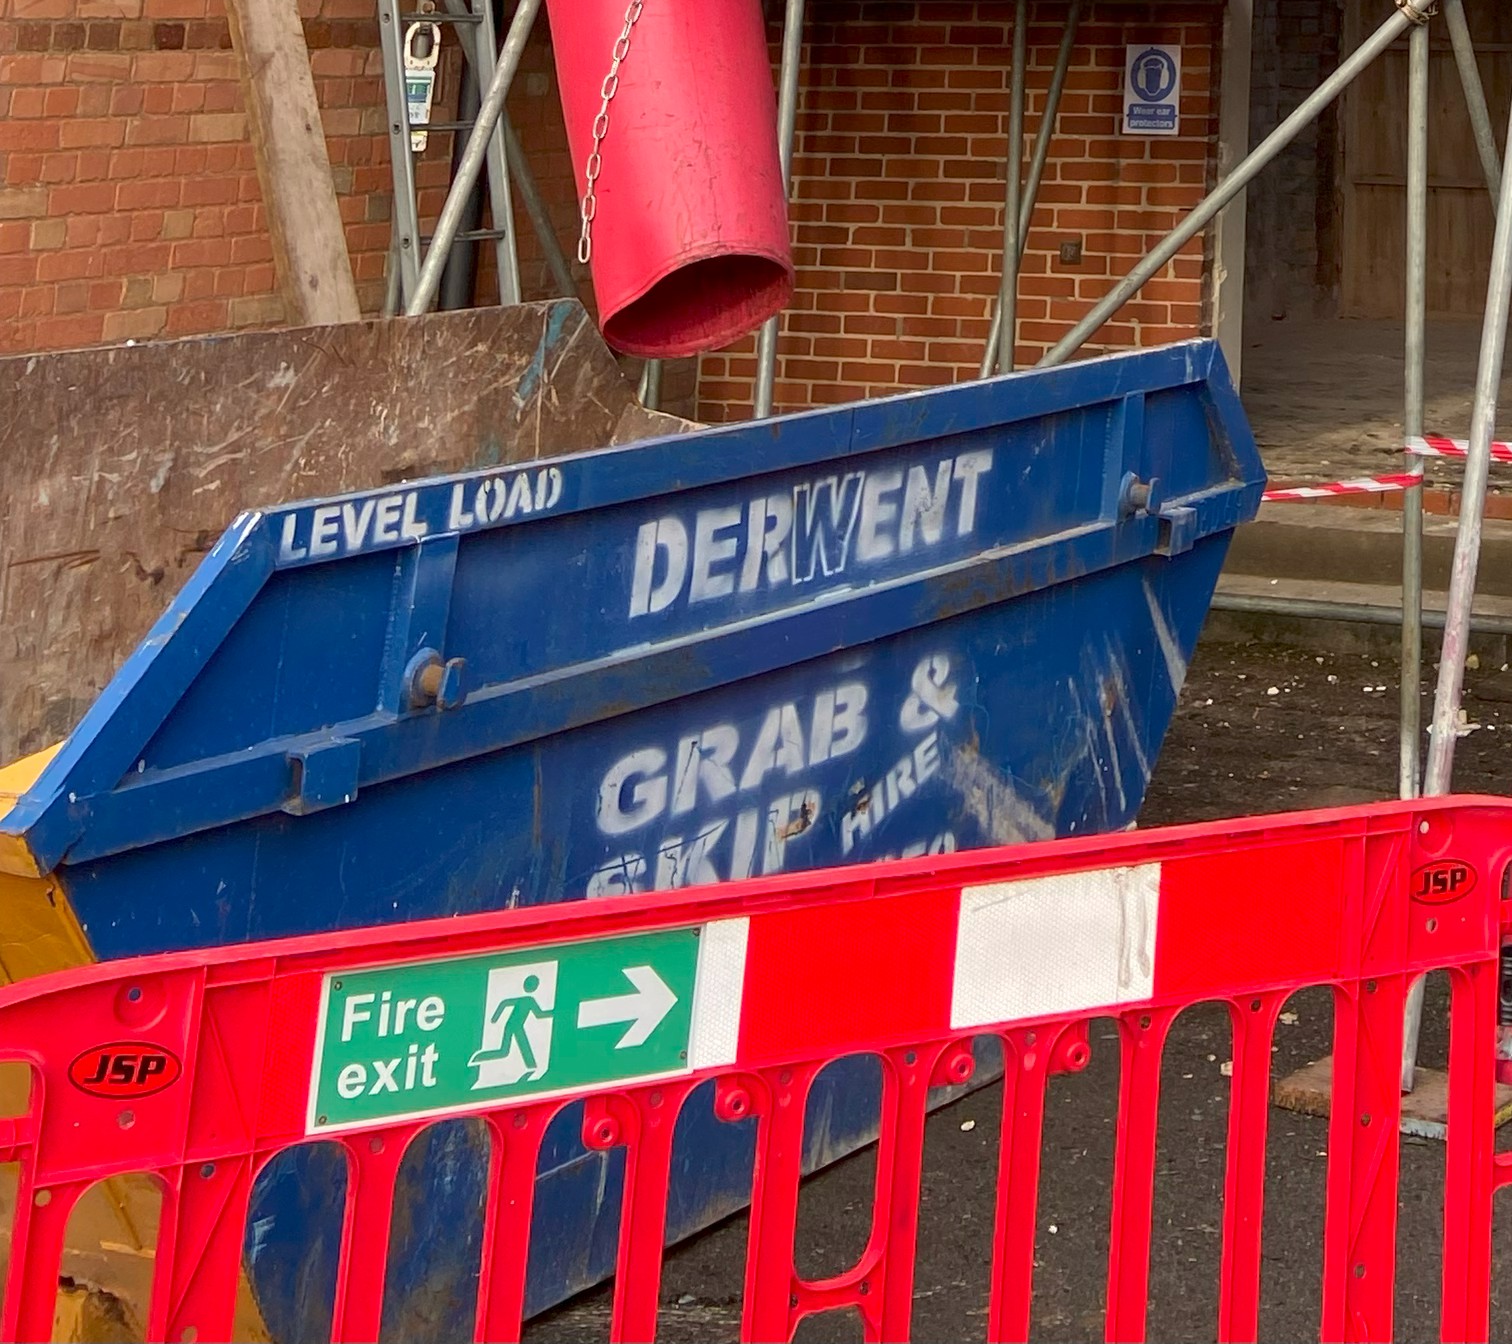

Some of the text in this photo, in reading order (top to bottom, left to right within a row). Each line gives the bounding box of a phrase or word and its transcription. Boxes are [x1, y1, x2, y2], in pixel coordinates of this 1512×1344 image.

[279, 467, 563, 562] LEVEL LOAD
[629, 448, 994, 619] DERWENT
[597, 653, 960, 834] GRAB &
[841, 730, 942, 856] HIRE
[1415, 866, 1468, 896] JSP
[341, 990, 446, 1042] Fire
[82, 1054, 167, 1086] JSP
[336, 1042, 440, 1099] exit
